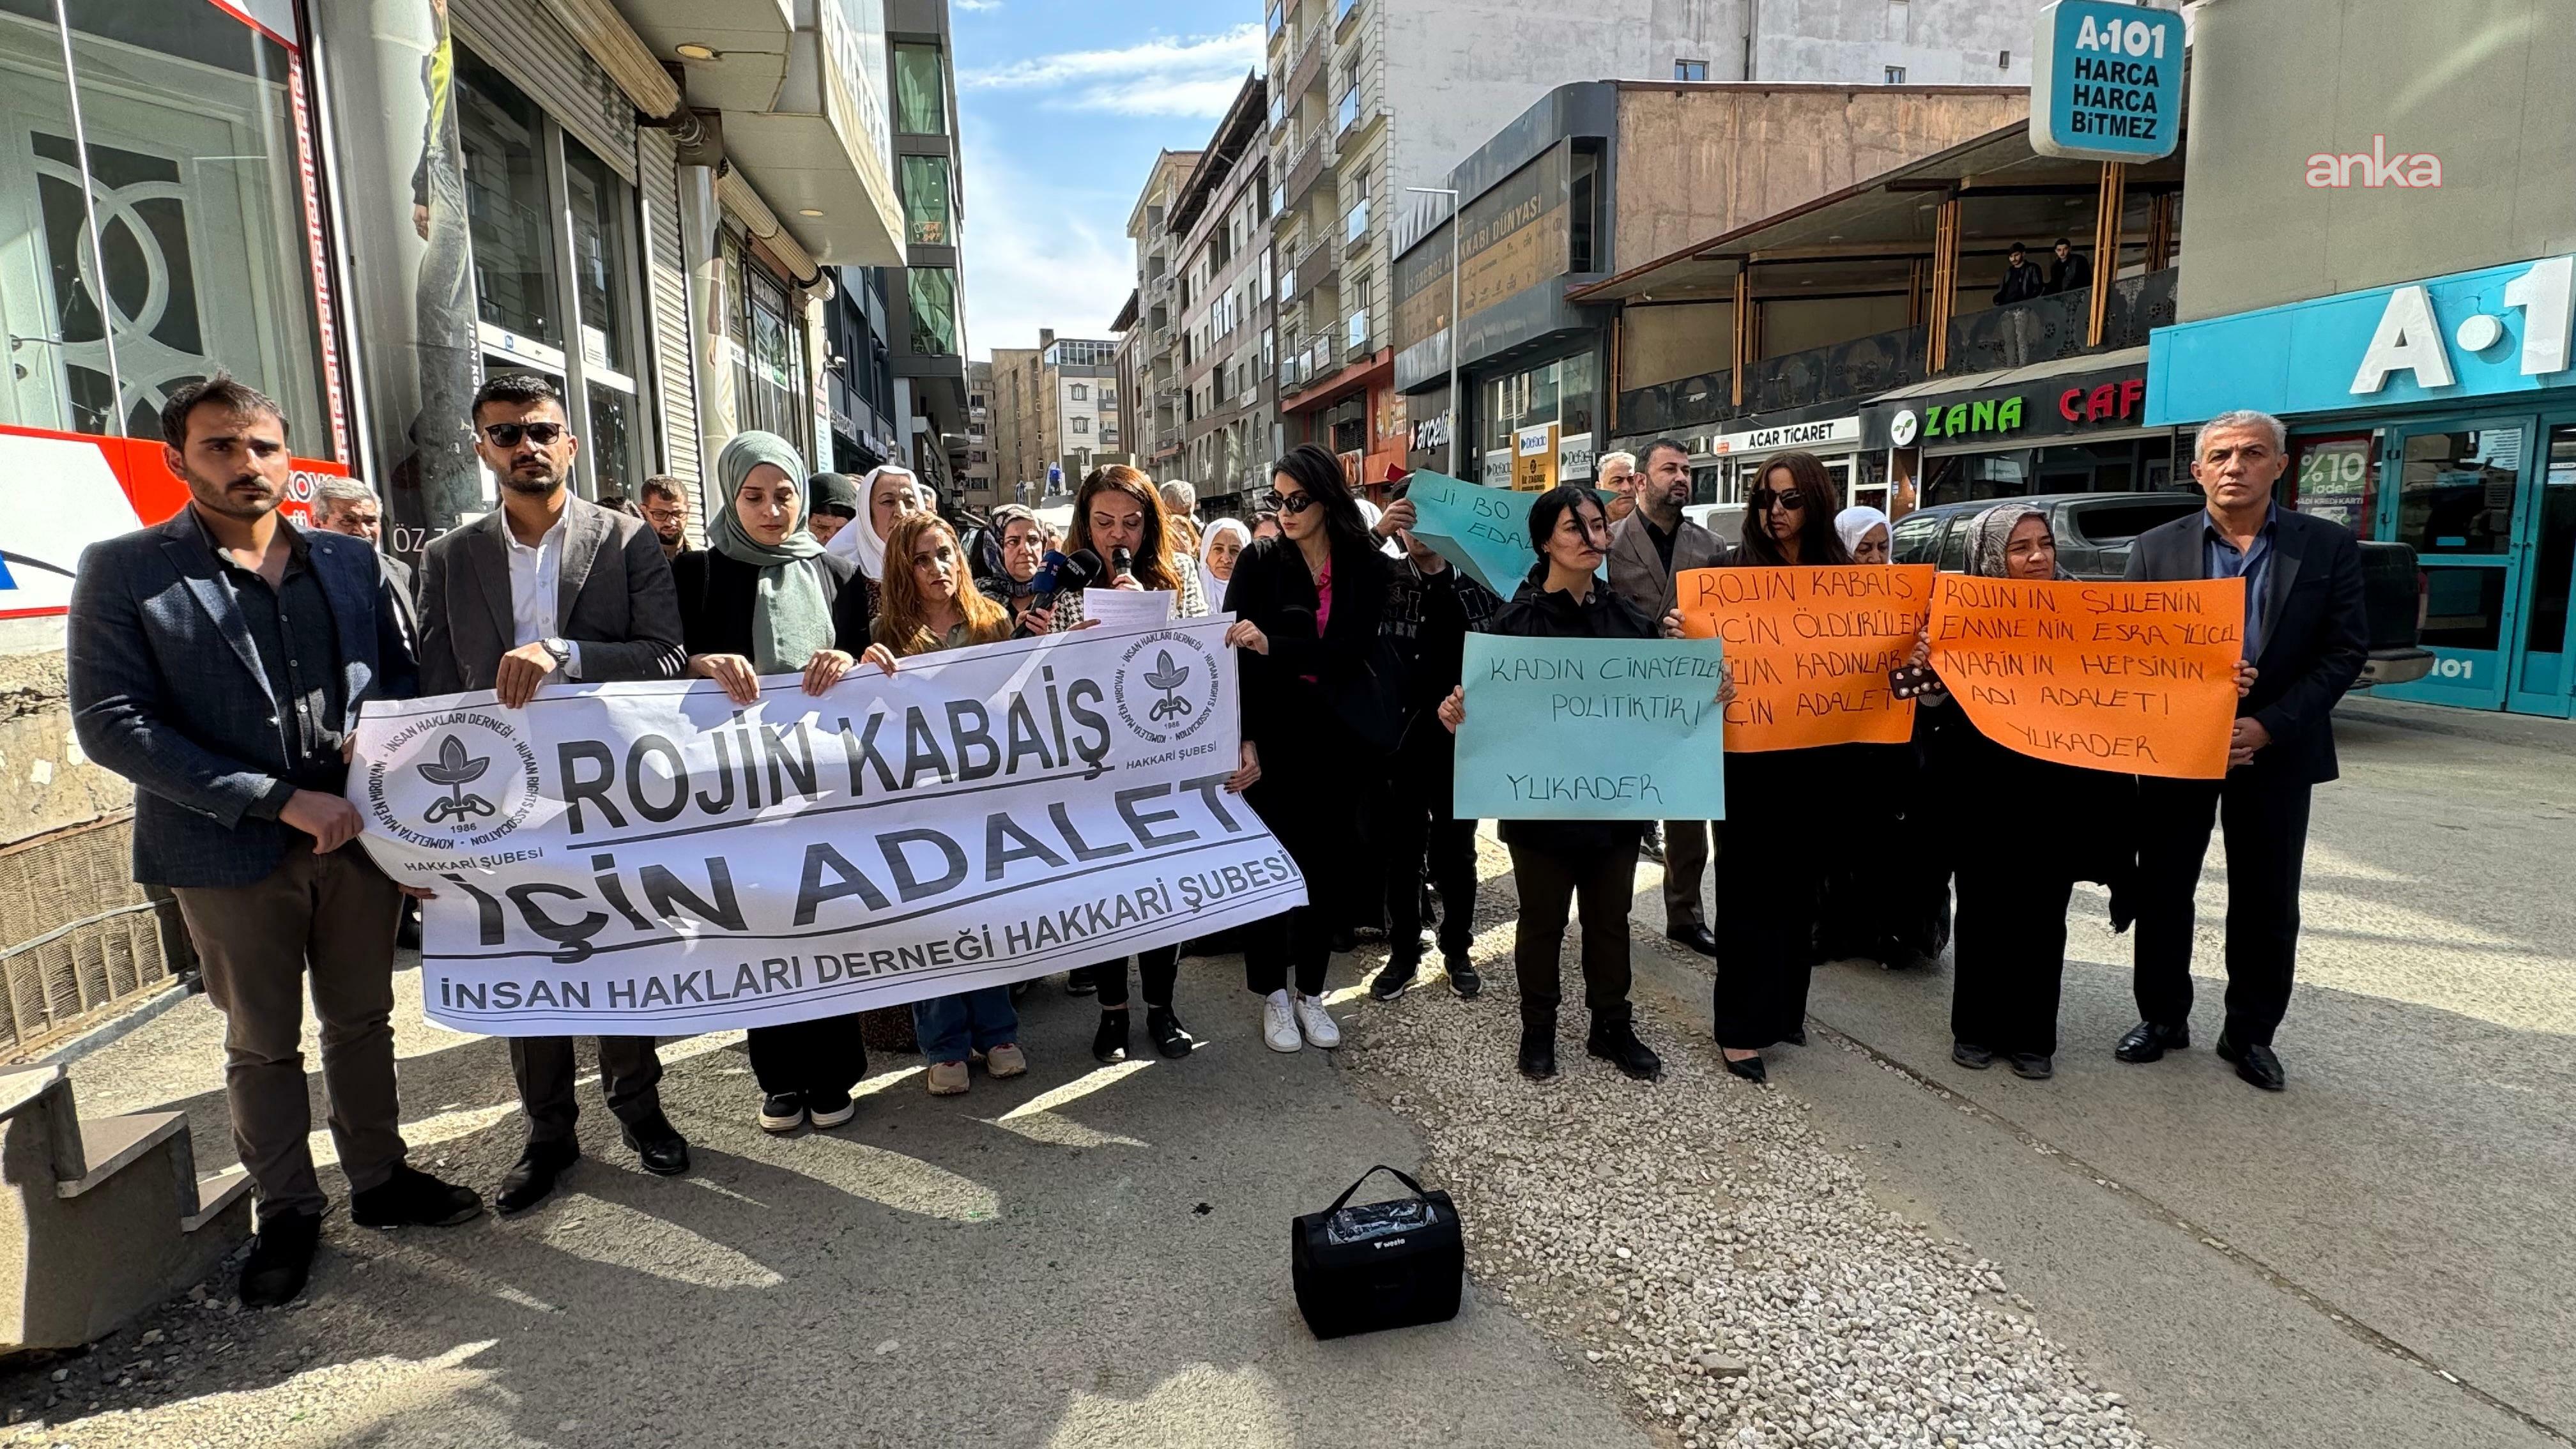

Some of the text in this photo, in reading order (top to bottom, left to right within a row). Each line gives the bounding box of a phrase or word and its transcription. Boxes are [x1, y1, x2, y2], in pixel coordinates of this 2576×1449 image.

[2074, 57, 2159, 88] HARCA
[2073, 84, 2157, 114] HARCA
[1445, 228, 1489, 268] AYKKABI
[1924, 378, 2143, 438] ZANA CAF
[1749, 429, 1780, 449] ACAR
[2300, 452, 2365, 482] %10
[1473, 496, 1510, 520] BO
[393, 523, 425, 553] ÖZ
[1698, 570, 1796, 607] ROJİN
[1141, 631, 1172, 647] HAKLARI
[2092, 623, 2170, 646] ESRA
[1204, 653, 1218, 679] HUMAN
[1491, 657, 1584, 682] KADIN
[2081, 654, 2204, 682] HEPSİNİN
[1208, 680, 1218, 707] RIGHTS
[1972, 685, 2016, 705] ADI
[416, 713, 465, 733] HAKLARI
[468, 713, 516, 739] DERNEĞİ
[1176, 707, 1212, 741] ASSOCIATION
[1724, 698, 1773, 726] ÇİN
[514, 741, 538, 774] HUMAN
[557, 665, 1112, 835] ROJİN KABAİŞ
[1126, 740, 1216, 770] HAKKARİ ŞUBESİ
[2006, 722, 2158, 763] YUKADER
[525, 777, 539, 809] RIGHTS
[1506, 774, 1663, 804] YUKADER
[398, 828, 454, 849] KOMELEYA
[450, 823, 477, 834] 1986
[471, 809, 527, 847] ASSOCIATION
[404, 847, 543, 872] HAKKARİ ŞUBESİ
[439, 770, 1244, 964] İÇİN ADALET
[441, 850, 1300, 1010] İNSAN HAKLARI DERNEĞİ HAKKARİ ŞUBESİ
